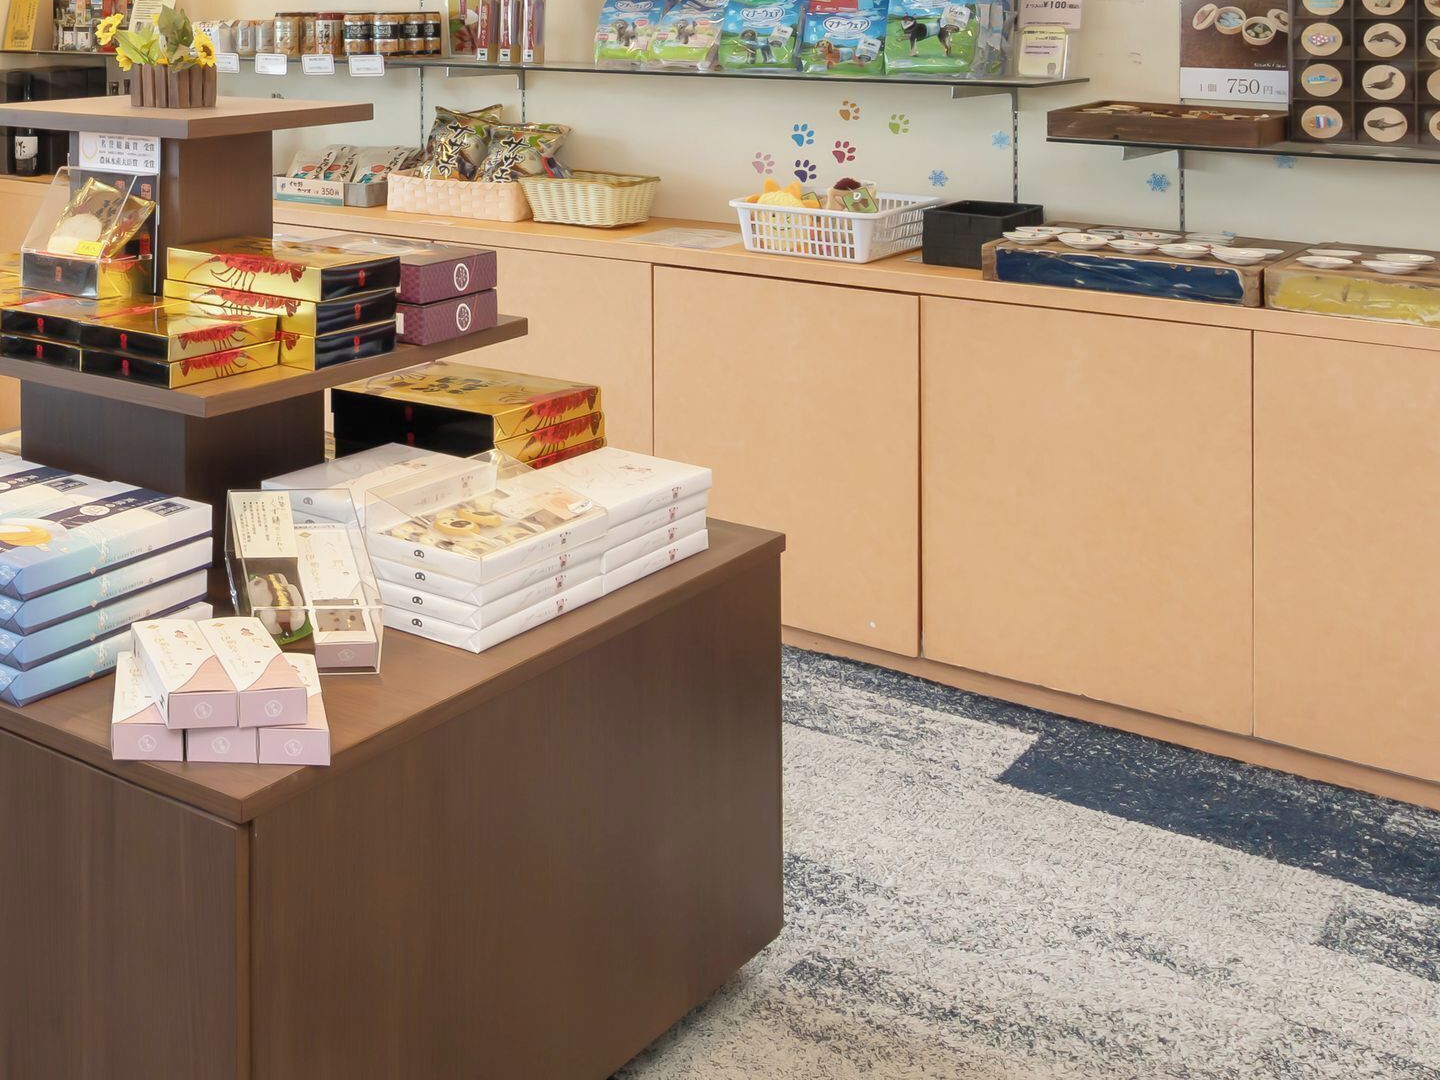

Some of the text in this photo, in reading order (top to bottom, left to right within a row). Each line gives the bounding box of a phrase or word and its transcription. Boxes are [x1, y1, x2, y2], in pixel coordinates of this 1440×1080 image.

[743, 8, 781, 18] マナーウェア
[828, 20, 867, 31] マナーウェア
[143, 143, 155, 152] 受賞
[143, 159, 155, 169] 受賞
